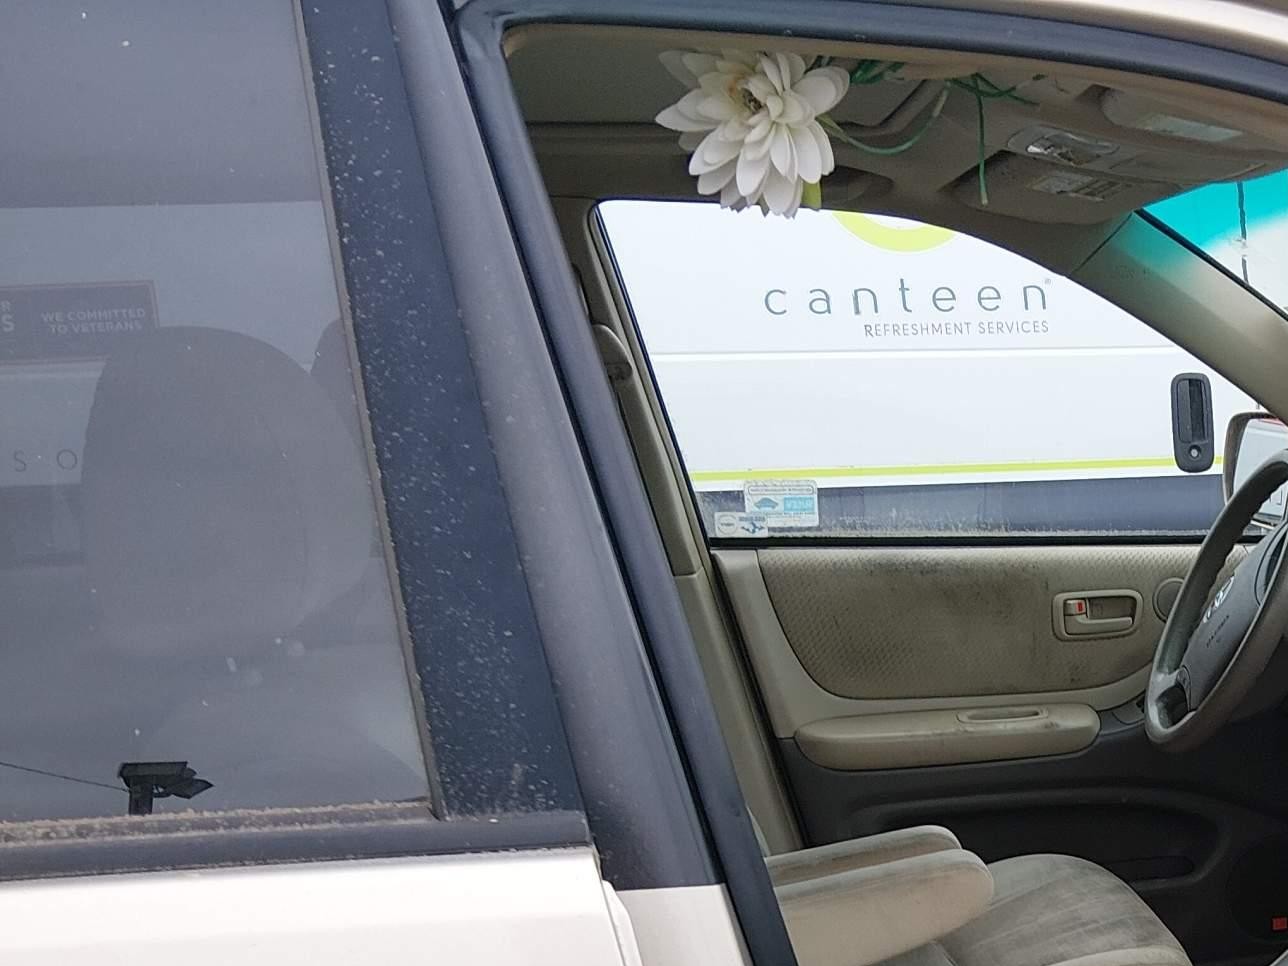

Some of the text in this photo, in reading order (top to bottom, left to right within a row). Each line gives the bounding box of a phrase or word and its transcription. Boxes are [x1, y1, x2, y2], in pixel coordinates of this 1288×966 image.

[764, 278, 1047, 316] canteen
[40, 307, 146, 322] WE COMMITTED
[48, 319, 143, 335] TO VETERANS
[864, 319, 1050, 338] REFRESHMENT SERVICES
